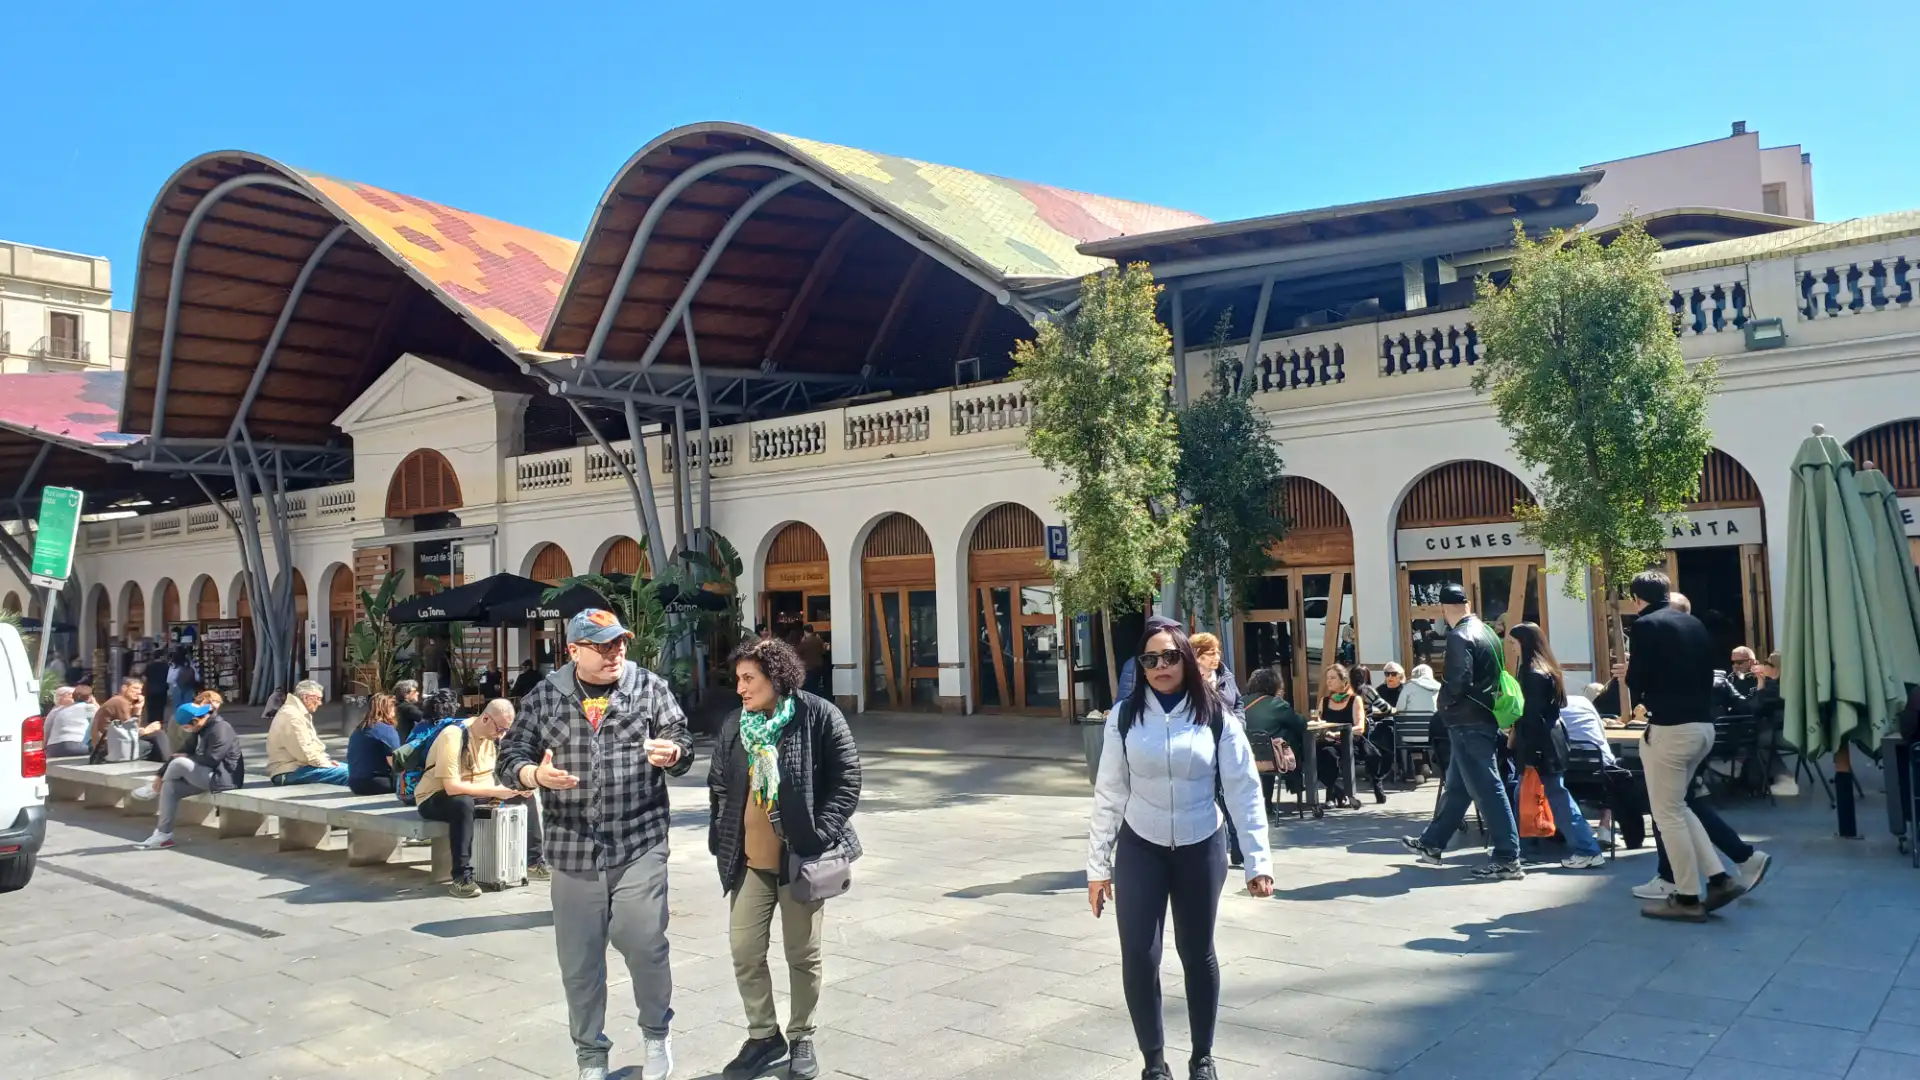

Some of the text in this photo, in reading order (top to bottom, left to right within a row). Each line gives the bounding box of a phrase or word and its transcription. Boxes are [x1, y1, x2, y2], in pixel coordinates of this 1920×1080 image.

[1051, 529, 1063, 553] P
[1426, 533, 1512, 550] CUINES
[420, 553, 440, 562] Mercat
[440, 552, 447, 561] de
[526, 606, 560, 618] La Torna
